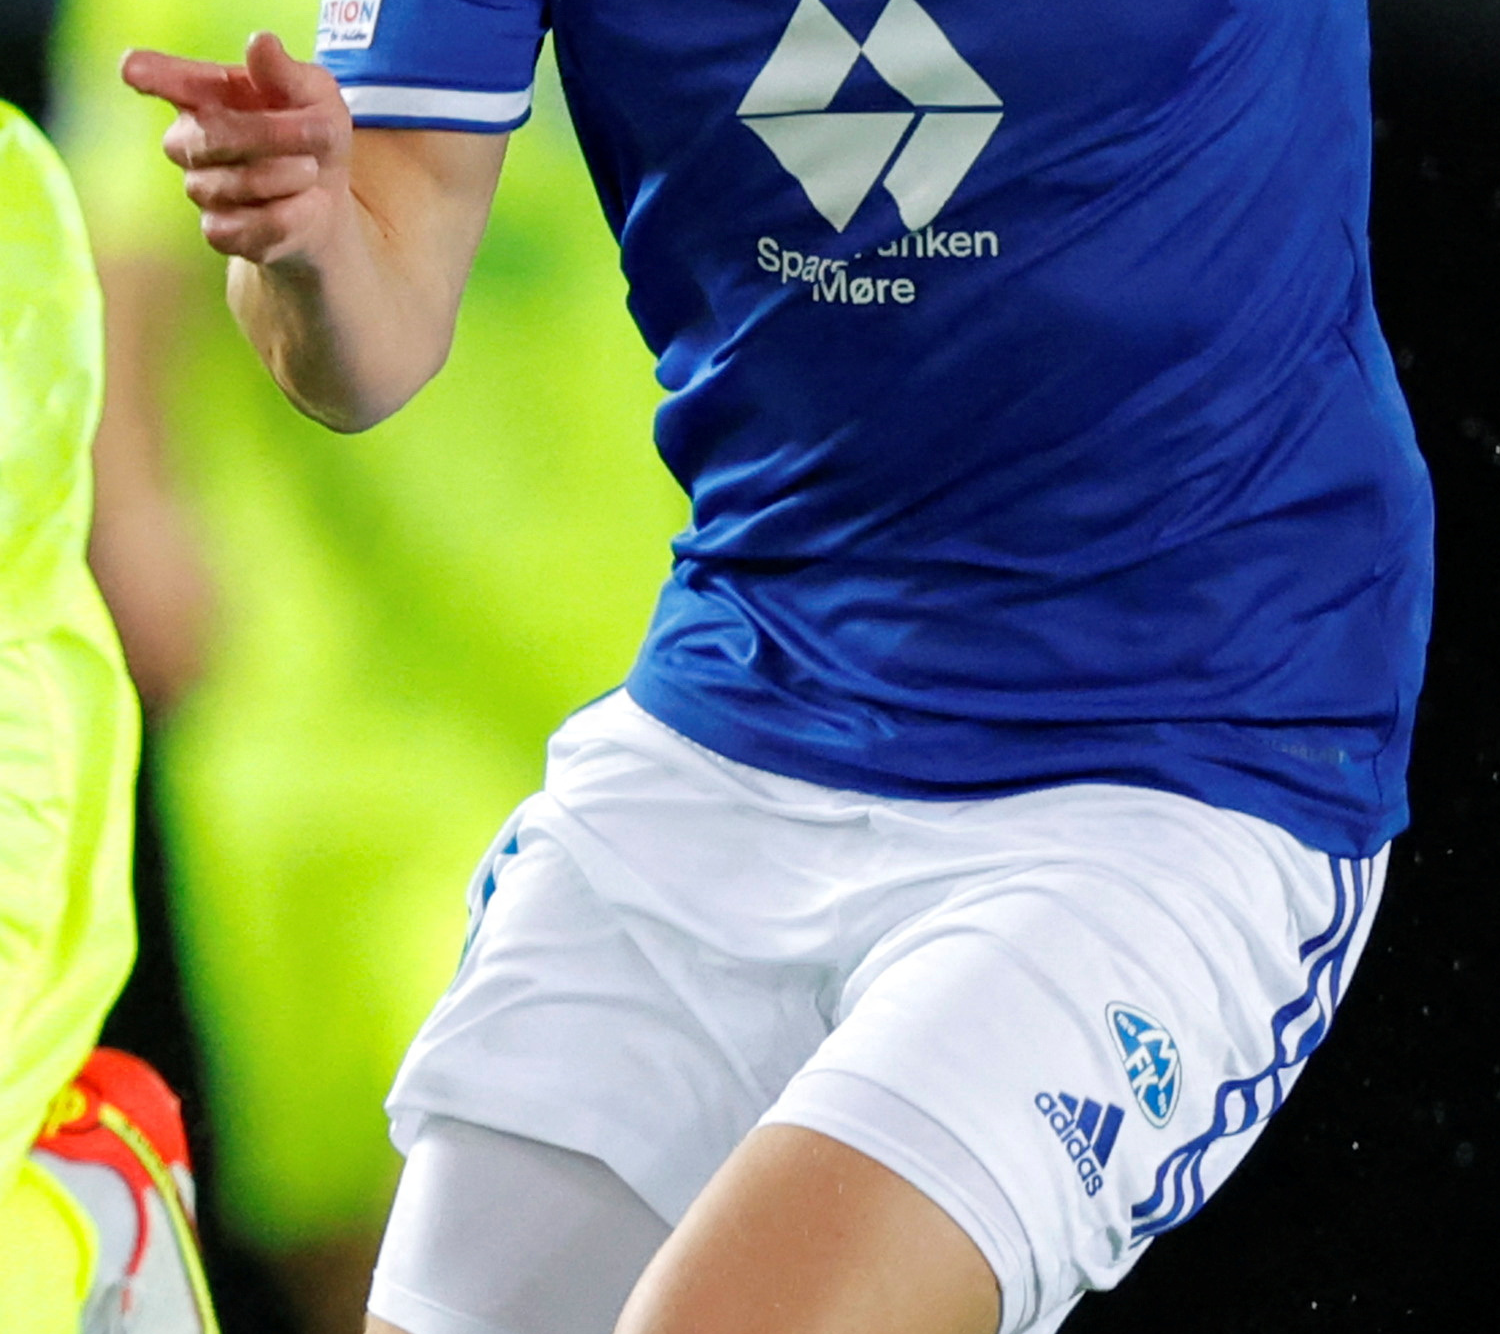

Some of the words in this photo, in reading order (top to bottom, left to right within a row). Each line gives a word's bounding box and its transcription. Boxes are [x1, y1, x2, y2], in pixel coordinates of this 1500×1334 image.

[757, 225, 999, 285] Sparanken
[812, 268, 916, 305] Møre
[1034, 1091, 1104, 1199] adidas
